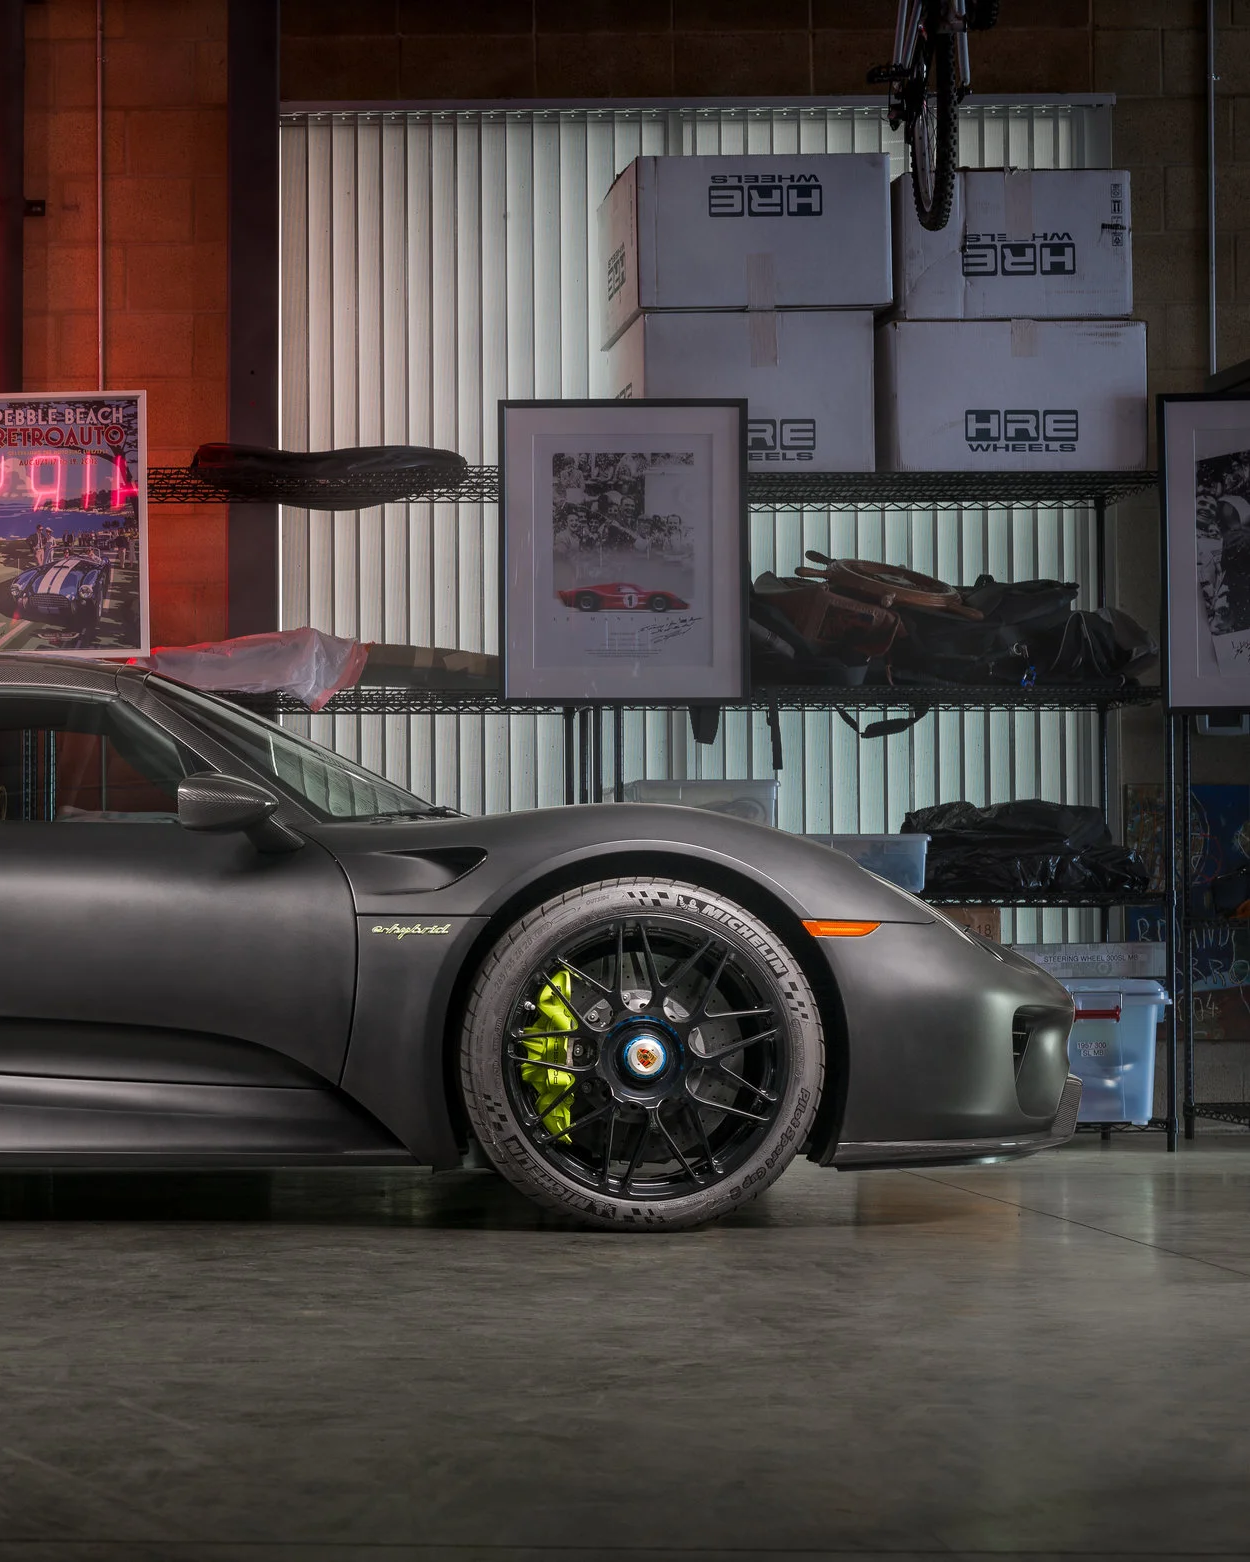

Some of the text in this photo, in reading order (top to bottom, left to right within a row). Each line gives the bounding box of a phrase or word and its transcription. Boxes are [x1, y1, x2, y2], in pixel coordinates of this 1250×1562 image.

[710, 174, 819, 183] WHEELS
[708, 184, 823, 217] HRE
[965, 232, 1073, 242] WHELS
[961, 242, 1076, 276] HRE
[64, 407, 124, 425] BEACH
[964, 409, 1079, 442] HRE
[747, 418, 816, 451] RE
[967, 443, 1077, 453] WHEELS
[748, 452, 814, 461] EELS
[627, 594, 633, 607] 1
[701, 902, 787, 977] MICHELIN
[1043, 955, 1079, 963] STEERING
[1106, 954, 1126, 962] 300SL
[788, 1087, 811, 1128] Pilot
[762, 1124, 798, 1169] Sport
[504, 1136, 591, 1211] MICHELIN
[739, 1164, 768, 1192] Cup
